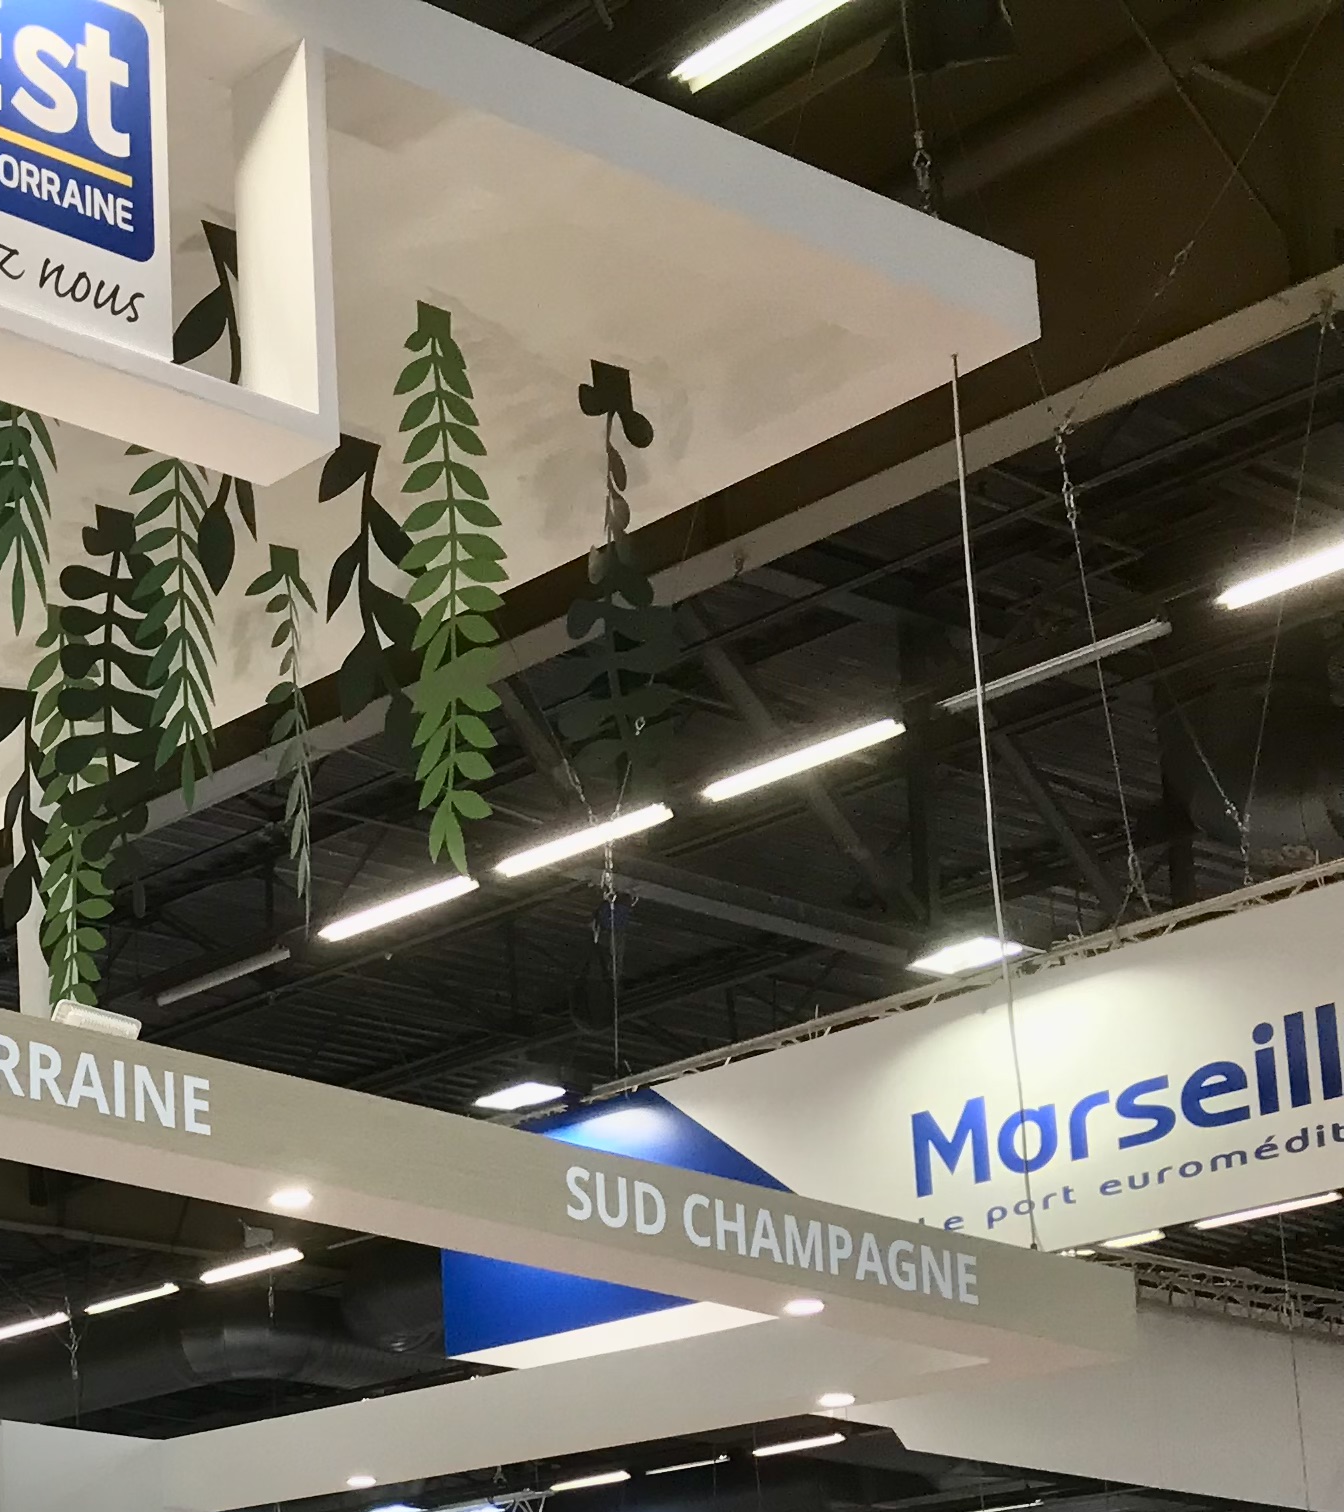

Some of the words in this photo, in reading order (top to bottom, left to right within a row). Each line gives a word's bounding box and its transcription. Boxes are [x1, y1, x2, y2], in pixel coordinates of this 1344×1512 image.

[39, 253, 145, 325] nous
[566, 1165, 667, 1237] SUD
[682, 1197, 981, 1306] CHAMPAGNE
[987, 1186, 1076, 1230] port
